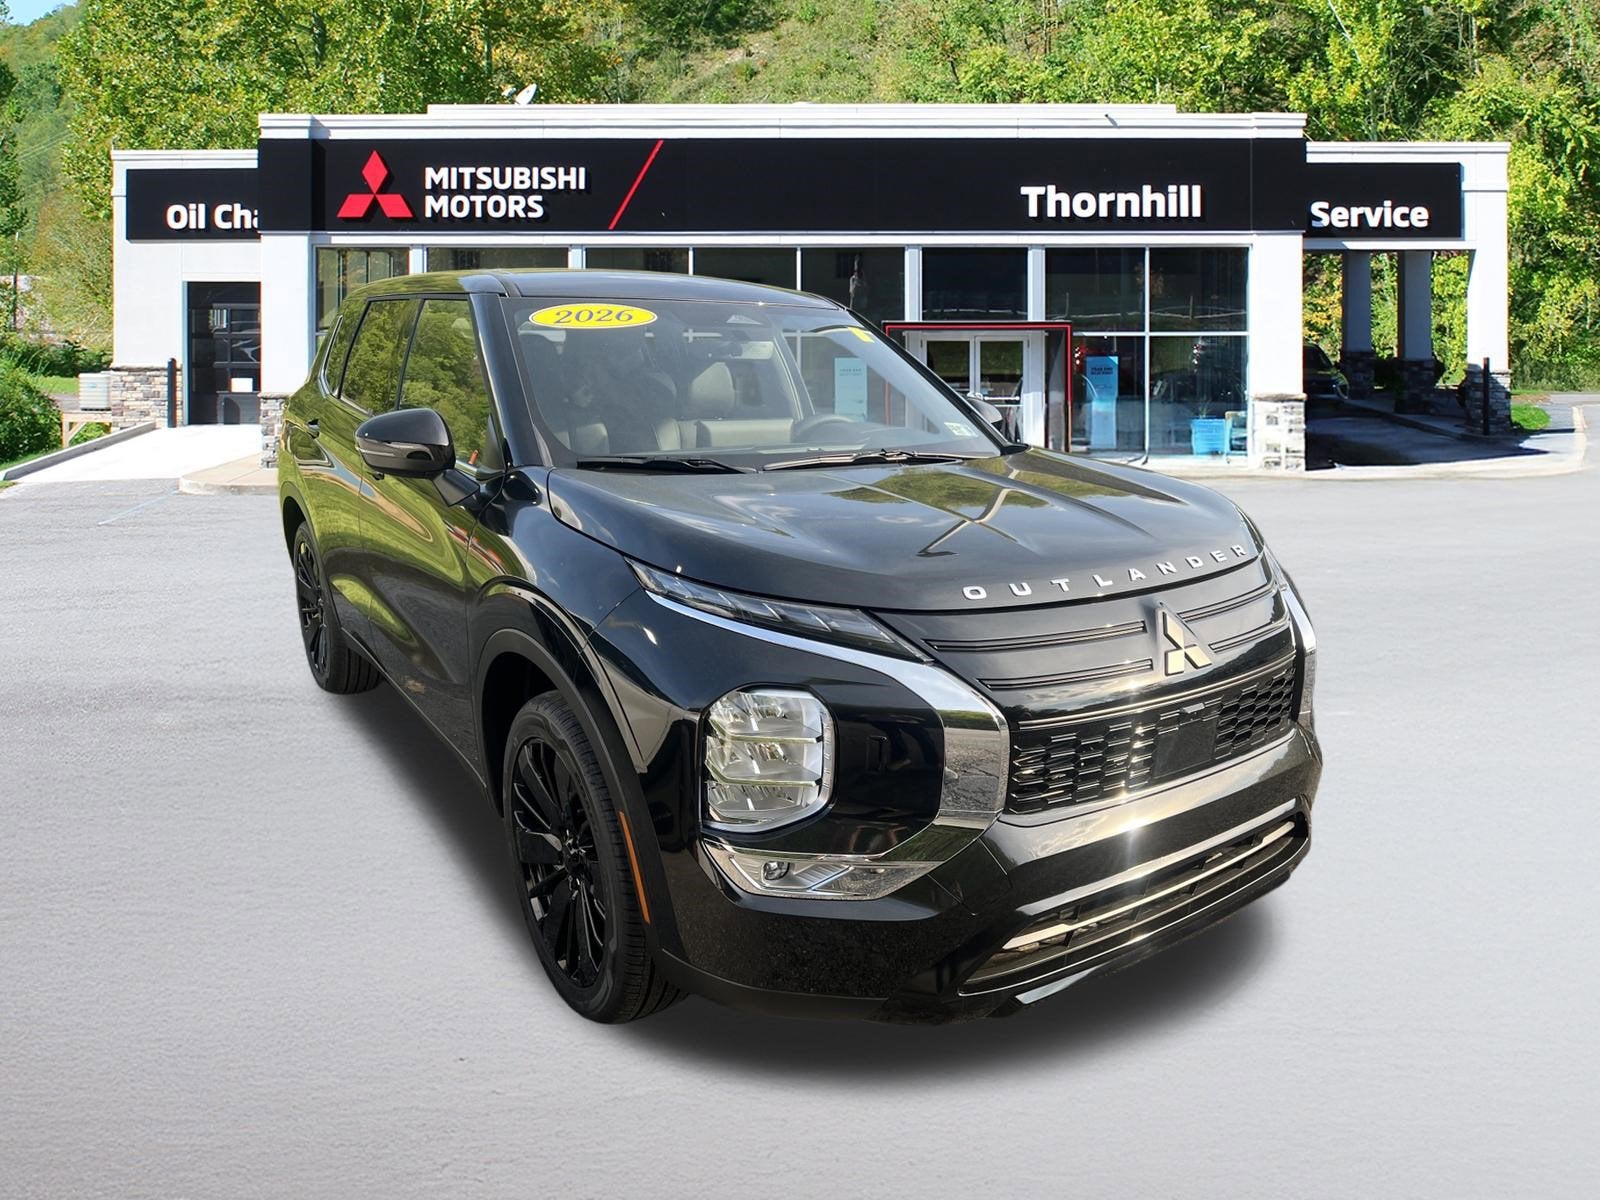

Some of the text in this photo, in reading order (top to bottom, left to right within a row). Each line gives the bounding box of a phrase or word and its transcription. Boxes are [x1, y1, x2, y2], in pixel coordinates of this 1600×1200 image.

[424, 166, 586, 190] MITSUBISHI
[424, 195, 545, 218] MOTORS
[1020, 184, 1202, 218] Thornhill
[1310, 200, 1429, 228] Service
[166, 203, 206, 230] Oil
[554, 303, 633, 324] 2026
[962, 544, 1247, 600] OUTLANDER
